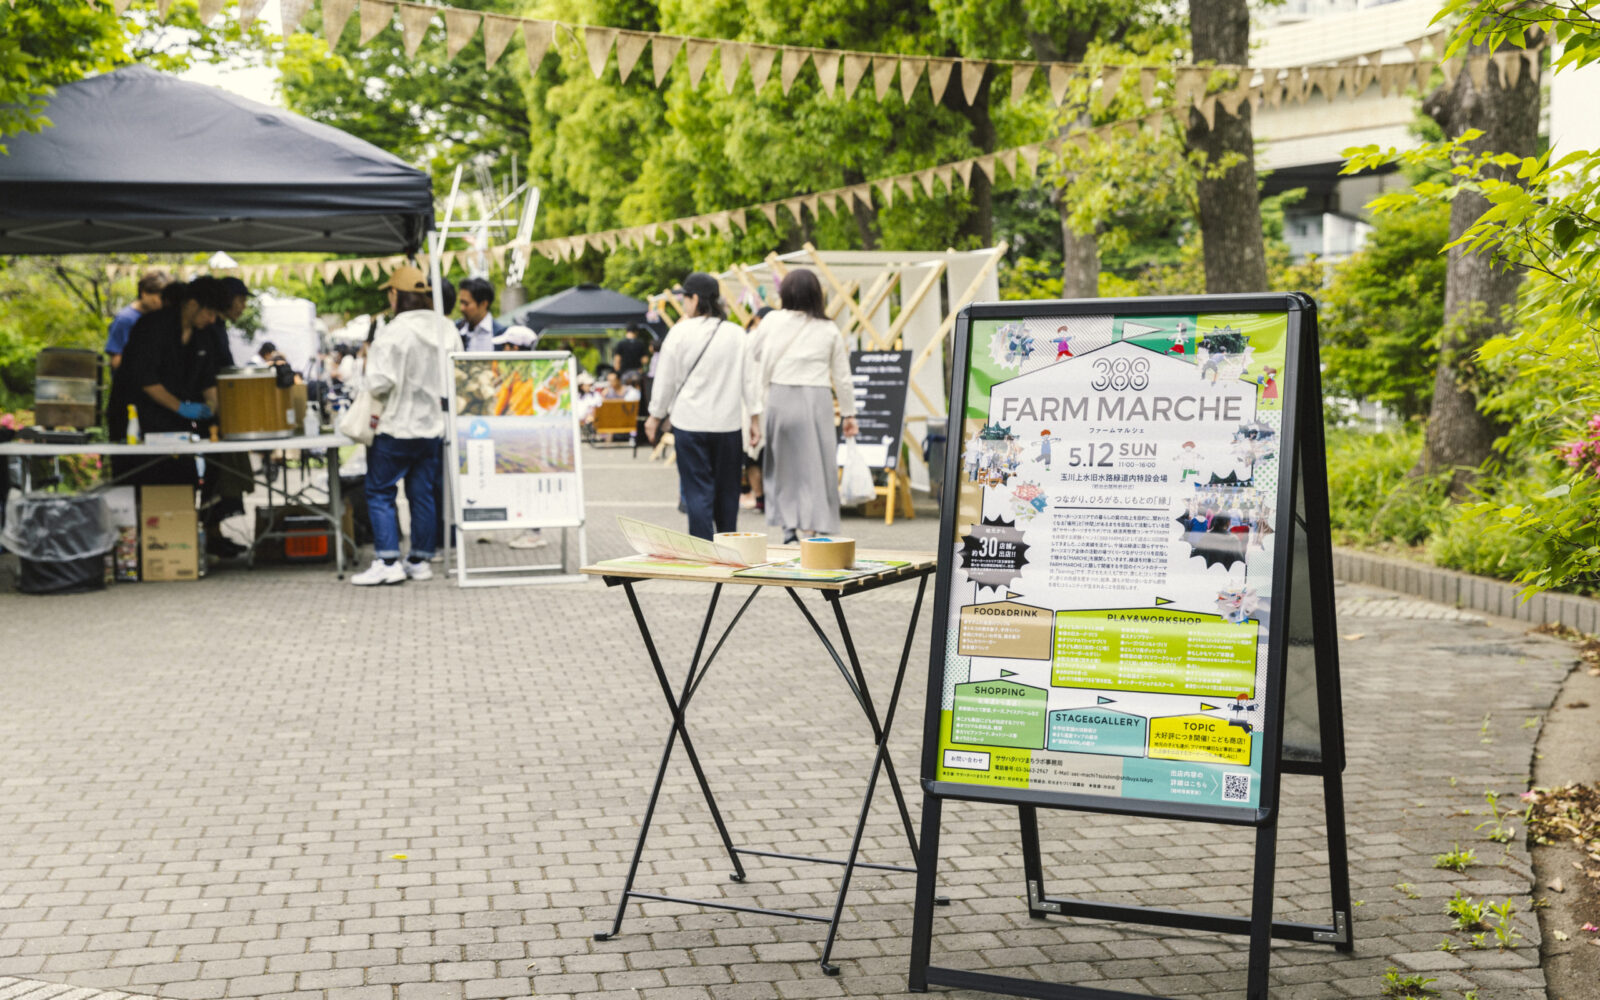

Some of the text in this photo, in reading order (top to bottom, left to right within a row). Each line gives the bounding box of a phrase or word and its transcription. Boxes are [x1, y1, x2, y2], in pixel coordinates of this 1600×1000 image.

[1091, 357, 1150, 391] 388
[1001, 396, 1242, 422] FARM MARCHE
[1068, 442, 1157, 467] 5.12 SUN
[1060, 473, 1168, 482] 玉川上水旧水路緑道内特設会場
[973, 607, 1038, 617] FOOD&DRINK
[1107, 613, 1202, 625] PLAY&WORKSHOP
[974, 686, 1026, 696] SHOPPING
[1055, 713, 1140, 726] STAGE&GALLERY
[1184, 722, 1216, 732] TOPIC
[951, 755, 983, 764] お問い合わせ
